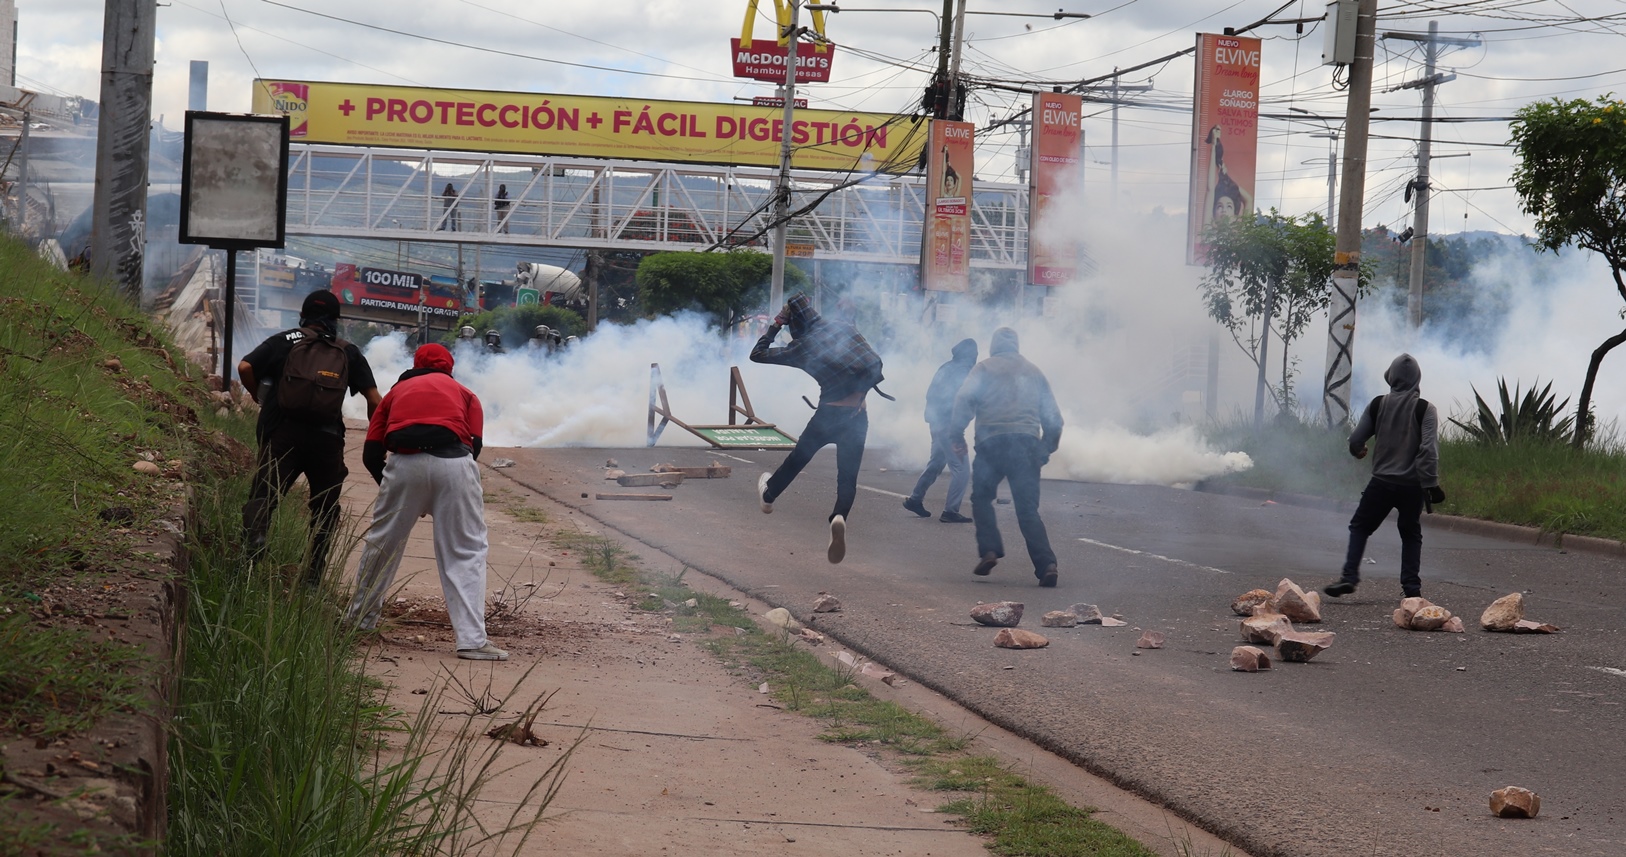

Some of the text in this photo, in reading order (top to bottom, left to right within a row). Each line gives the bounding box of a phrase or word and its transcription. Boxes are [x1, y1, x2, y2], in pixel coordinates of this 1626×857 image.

[1217, 39, 1239, 48] NUEVO
[1215, 47, 1260, 67] ELVIVE
[745, 65, 822, 78] Hamburuesas
[1215, 64, 1258, 86] Dream long
[1223, 89, 1253, 99] ¿LARGO
[275, 99, 307, 112] NIDO
[1219, 98, 1256, 109] SOÑADO?
[1043, 109, 1078, 127] ELVIVE
[1217, 107, 1258, 119] SALVA TUS
[365, 98, 580, 131] PROTECCIÓN
[612, 105, 707, 139] FÁCIL
[715, 115, 888, 149] DIGESTIÓN
[944, 127, 970, 139] ELVIVE
[1227, 127, 1246, 137] 3 CM
[365, 270, 419, 289] 100 MIL
[360, 298, 397, 309] PARTICIPA
